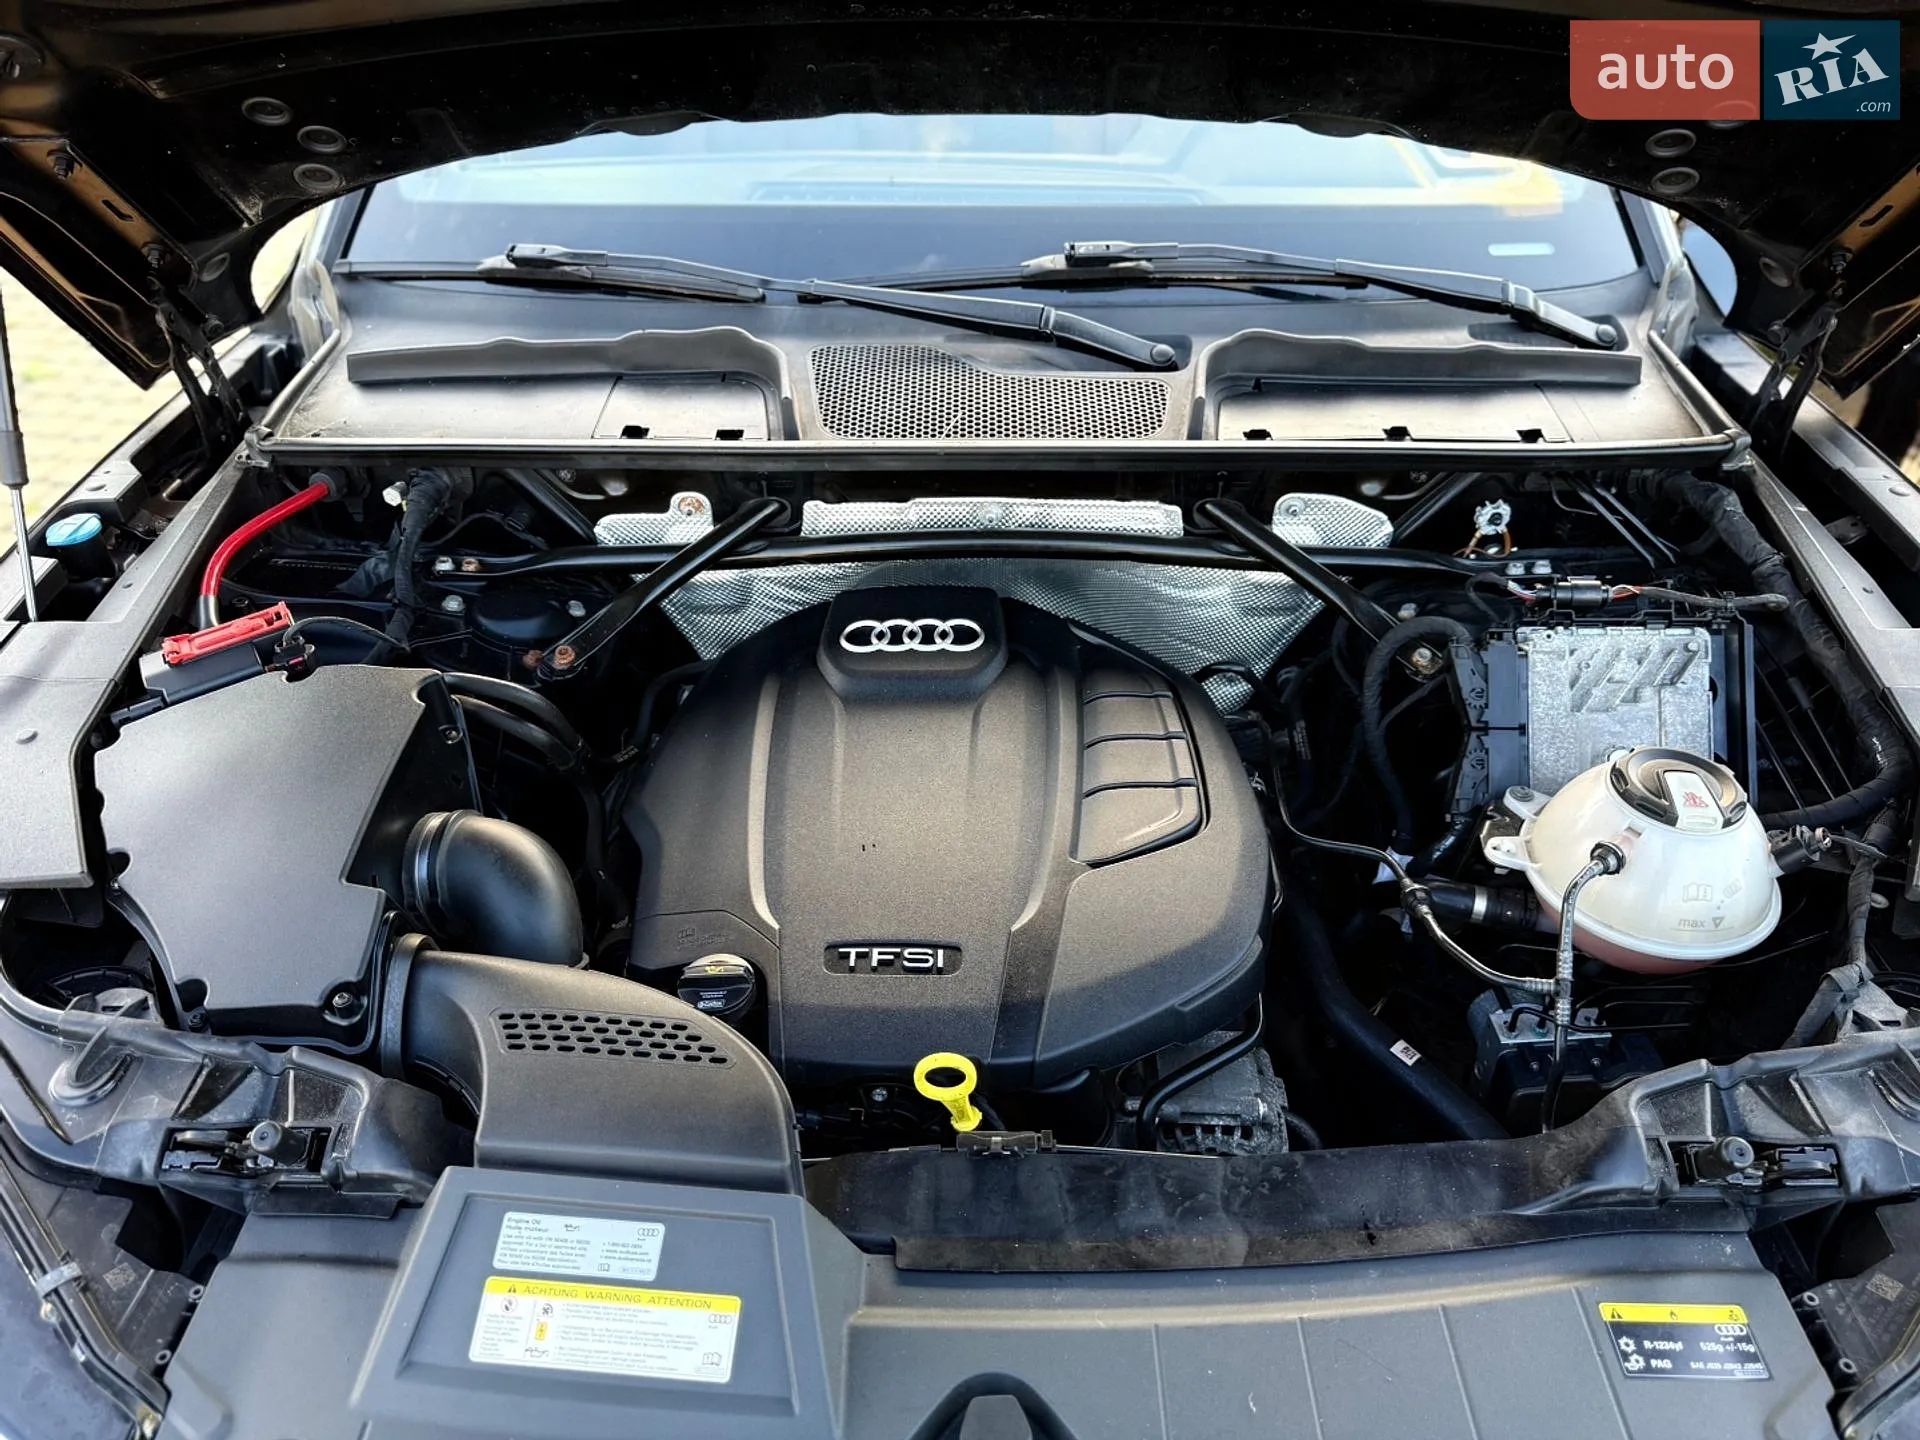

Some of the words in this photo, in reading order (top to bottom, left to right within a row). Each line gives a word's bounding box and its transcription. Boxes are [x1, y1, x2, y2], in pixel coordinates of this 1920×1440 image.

[1678, 918, 1706, 928] max
[838, 948, 944, 968] TFSI
[507, 1217, 530, 1225] Engine
[523, 1285, 578, 1299] ACHTUNG
[585, 1291, 641, 1304] WARNING
[647, 1295, 712, 1309] ATTENTION
[1650, 1358, 1673, 1368] PAG
